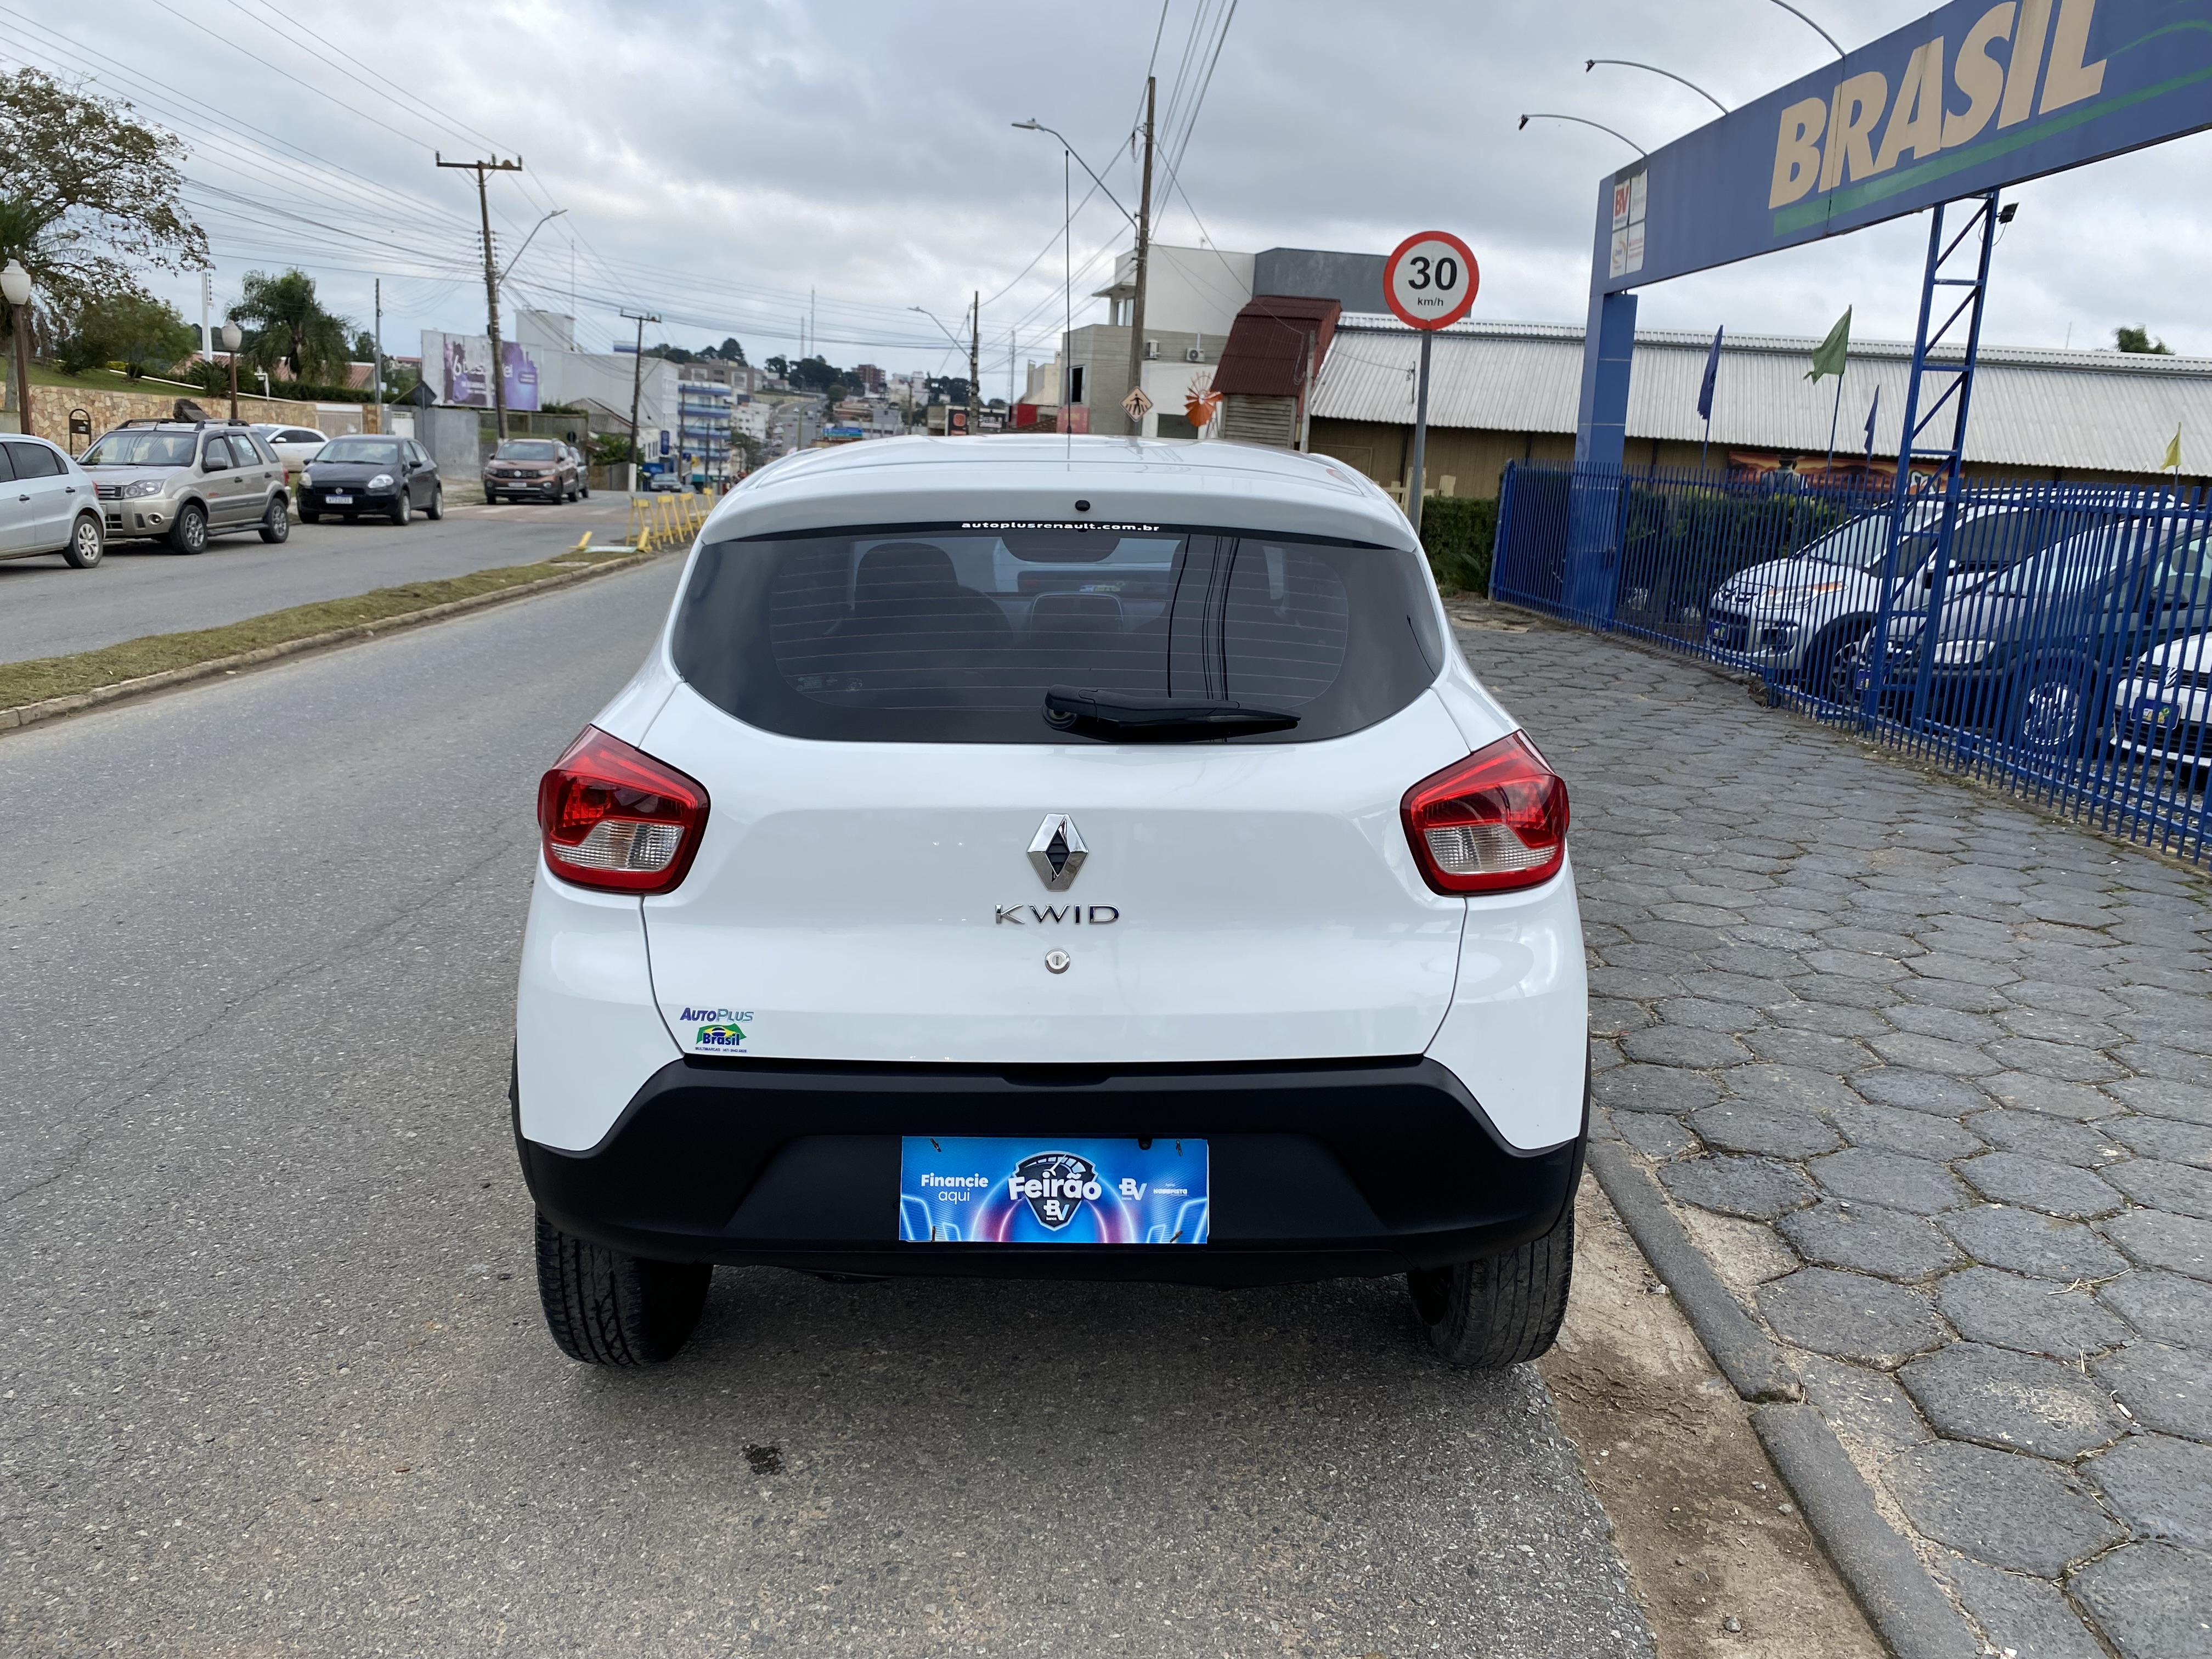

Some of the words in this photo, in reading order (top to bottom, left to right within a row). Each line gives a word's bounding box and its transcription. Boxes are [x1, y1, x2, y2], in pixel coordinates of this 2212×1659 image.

[1769, 0, 2108, 210] BRASIL
[1615, 184, 1629, 217] BV
[1408, 256, 1457, 291] 30
[1417, 297, 1444, 306] km/h
[961, 522, 1160, 531] autoplusrenault.com.br
[995, 904, 1120, 924] KWID
[703, 1032, 740, 1046] Brasil
[921, 1172, 989, 1187] Financie
[1008, 1171, 1102, 1200] Feirão
[1119, 1178, 1147, 1200] BV
[938, 1188, 970, 1205] aqui
[1043, 1199, 1070, 1221] BV
